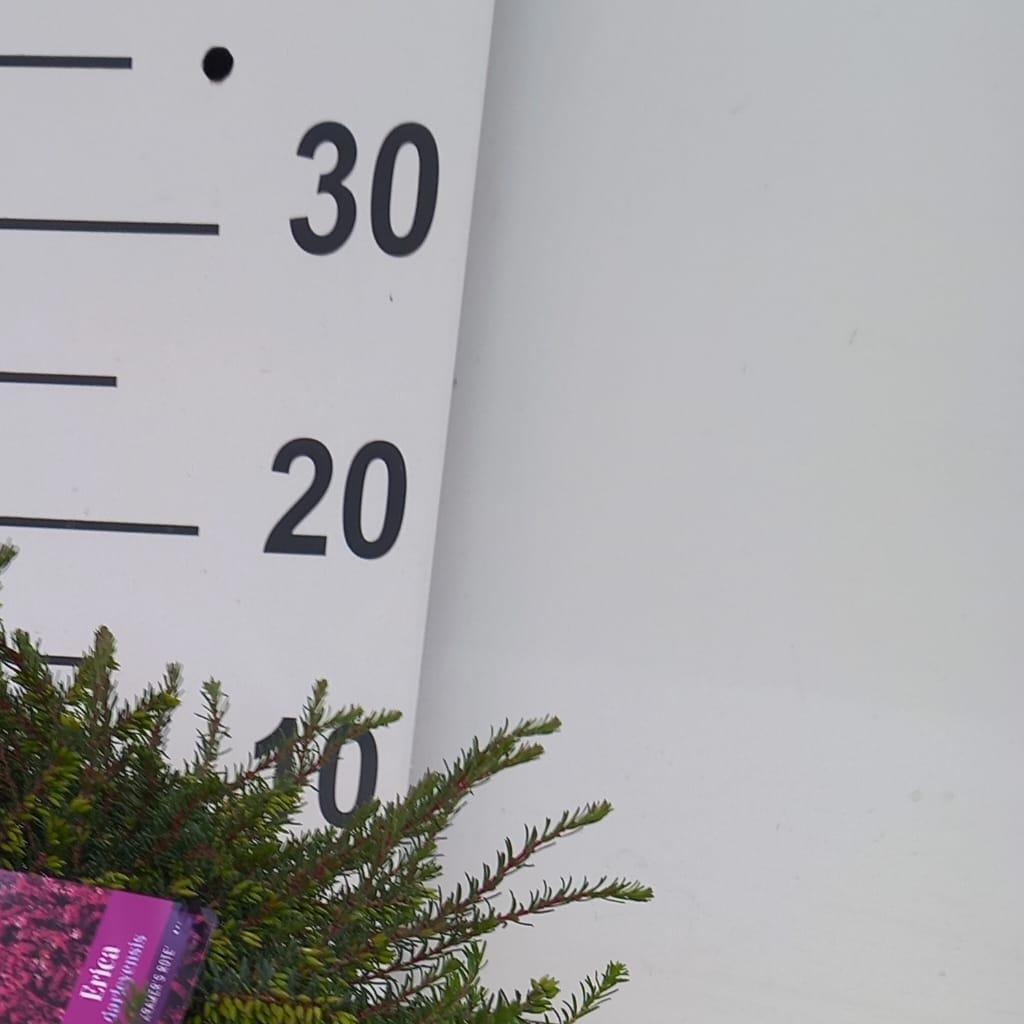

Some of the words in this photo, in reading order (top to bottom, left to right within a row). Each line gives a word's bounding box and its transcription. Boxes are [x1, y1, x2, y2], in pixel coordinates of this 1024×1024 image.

[289, 121, 439, 257] 30
[263, 438, 407, 560] 20
[255, 717, 378, 829] 10
[80, 945, 120, 1001] Erica
